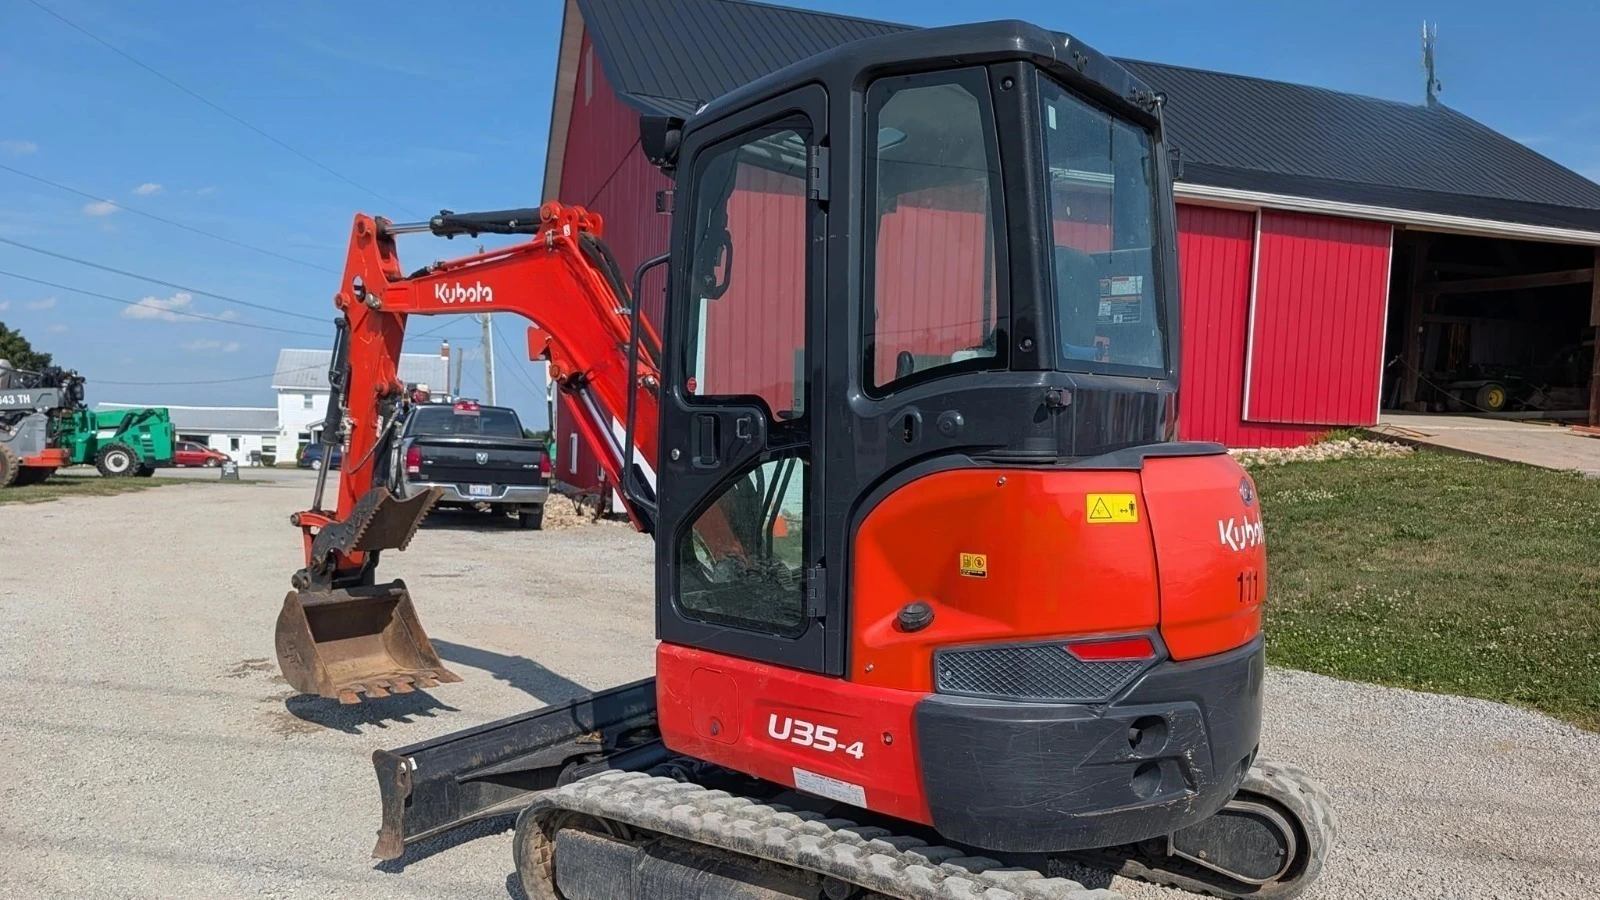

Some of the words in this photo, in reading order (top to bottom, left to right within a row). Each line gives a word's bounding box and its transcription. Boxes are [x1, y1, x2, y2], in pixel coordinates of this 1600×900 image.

[434, 281, 493, 304] Kubota
[17, 394, 31, 404] TH
[1237, 571, 1258, 603] 111
[768, 713, 864, 759] U35-4
